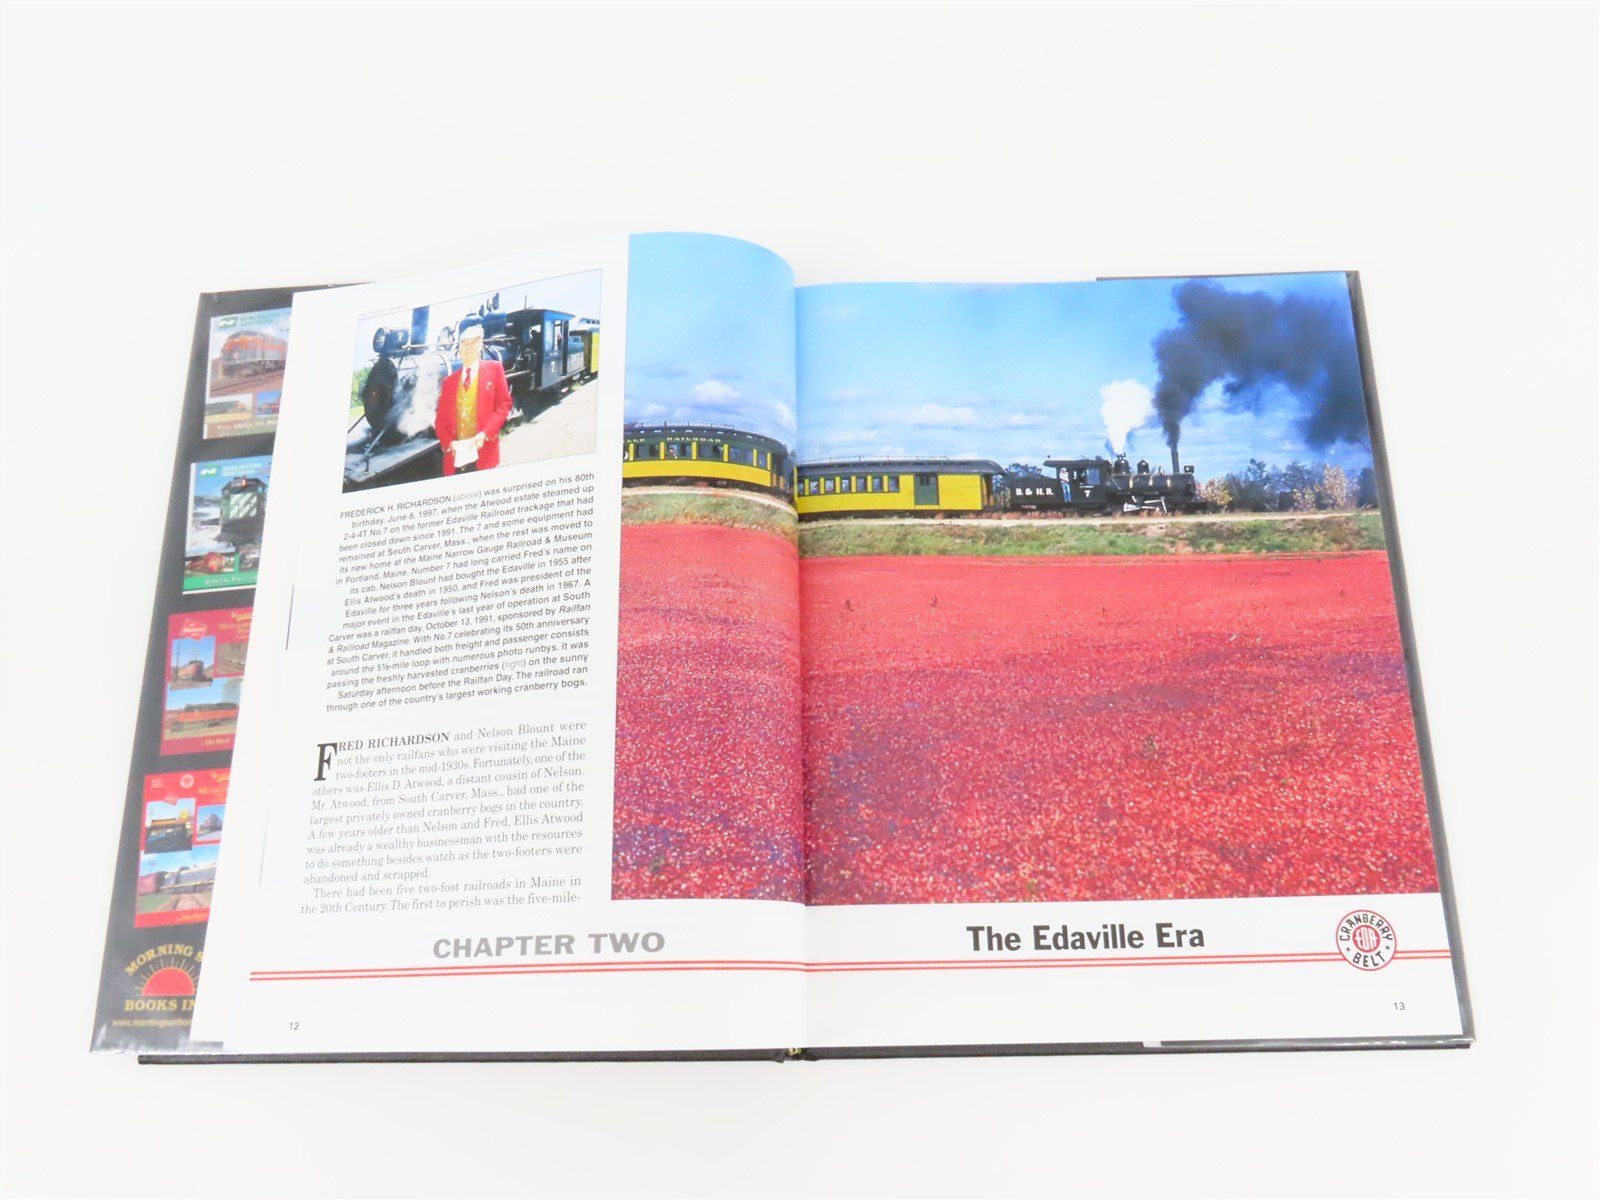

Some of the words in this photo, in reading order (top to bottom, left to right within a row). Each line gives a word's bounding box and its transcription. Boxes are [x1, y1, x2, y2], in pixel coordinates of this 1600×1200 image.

[340, 506, 385, 519] FREDERICK
[396, 495, 452, 511] RICHARDSON
[484, 488, 500, 496] was
[502, 480, 543, 493] surprised
[545, 479, 556, 487] on
[559, 476, 572, 484] his
[574, 472, 594, 482] 80th
[1025, 488, 1033, 496] &
[1084, 490, 1090, 498] 7
[352, 518, 385, 529] birthday,
[387, 514, 407, 523] June
[409, 512, 416, 520] 8,
[418, 508, 439, 518] 1997,
[441, 505, 463, 514] when
[465, 503, 478, 511] the
[480, 496, 512, 508] Atwood
[514, 492, 540, 503] estate
[542, 485, 580, 498] steamed
[582, 485, 594, 494] up
[345, 607, 377, 618] Edaville
[392, 603, 414, 612] three
[416, 600, 438, 610] years
[440, 594, 478, 605] following
[480, 588, 517, 600] Nelson's
[519, 584, 544, 595] death
[546, 583, 555, 591] in
[558, 579, 581, 590] 1967.
[584, 579, 591, 587] A
[328, 633, 354, 643] Carver
[380, 626, 406, 636] railfan
[408, 625, 424, 633] day,
[426, 620, 458, 631] October
[461, 617, 472, 626] 13,
[474, 614, 496, 624] 1991,
[497, 608, 543, 622] sponsored
[545, 607, 556, 617] by
[559, 603, 590, 614] Railfan
[328, 646, 334, 654] &
[336, 641, 370, 653] Railroad
[371, 638, 411, 650] Magazine.
[413, 635, 432, 643] With
[433, 631, 452, 642] No.7
[454, 626, 501, 639] celebrating
[516, 621, 534, 631] 50th
[536, 617, 590, 629] anniversary
[330, 666, 360, 677] around
[362, 665, 375, 673] the
[412, 659, 430, 668] loop
[432, 656, 450, 665] with
[452, 651, 495, 663] numerous
[497, 648, 523, 659] photo
[525, 644, 559, 654] runbys.
[562, 642, 568, 650] It
[570, 641, 589, 649] was
[326, 701, 358, 712] through
[378, 698, 387, 707] of
[389, 698, 402, 706] the
[404, 692, 444, 704] country's
[446, 689, 475, 701] largest
[477, 686, 512, 696] working
[514, 682, 559, 692] cranberry
[561, 679, 587, 689] bogs.
[338, 689, 374, 699] Saturday
[376, 684, 417, 695] afternoon
[418, 681, 446, 691] before
[448, 679, 462, 688] the
[464, 675, 494, 685] Railfan
[496, 673, 514, 683] Day.
[516, 671, 532, 679] The
[534, 666, 570, 678] railroad
[368, 732, 449, 749] RICHARDSON
[454, 730, 473, 741] and
[477, 727, 513, 739] Nelson
[518, 724, 554, 735] Blount
[559, 722, 586, 731] were
[336, 757, 352, 766] not
[355, 754, 372, 765] the
[373, 751, 394, 764] only
[397, 749, 436, 761] railfans
[438, 746, 459, 757] who
[461, 746, 486, 755] were
[488, 740, 528, 752] visiting
[530, 738, 548, 749] the
[551, 735, 586, 747] Maine
[310, 815, 343, 827] largest
[346, 810, 391, 826] privately
[392, 807, 425, 820] owned
[427, 804, 478, 817] cranberry
[480, 802, 503, 815] bogs
[506, 800, 516, 811] in
[519, 799, 536, 811] the
[307, 846, 326, 855] was
[327, 841, 365, 854] already
[366, 843, 373, 851] a
[376, 838, 414, 851] wealthy
[417, 835, 482, 848] businessman
[485, 831, 508, 843] with
[511, 831, 528, 842] the
[531, 830, 583, 840] resources
[305, 861, 315, 870] to
[316, 858, 330, 869] do
[330, 855, 384, 868] something
[386, 853, 422, 865] besides
[425, 850, 456, 862] watch
[458, 852, 470, 861] as
[472, 849, 490, 860] the
[492, 846, 552, 858] two-footers
[555, 846, 582, 854] were
[313, 887, 343, 899] There
[346, 886, 365, 897] had
[368, 885, 392, 896] been
[396, 883, 415, 895] five
[418, 881, 459, 894] two-foot
[464, 878, 511, 891] railroads
[515, 878, 526, 889] in
[530, 876, 566, 888] Maine
[570, 875, 581, 886] in
[966, 926, 1021, 951] The
[1033, 924, 1144, 950] Edaville
[1156, 922, 1205, 948] Era
[1340, 914, 1393, 941] CRANBERRY
[433, 934, 575, 958] CHAPTER
[588, 932, 665, 953] TWO
[124, 944, 194, 976] MORNING
[1353, 951, 1385, 967] BELT
[124, 999, 178, 1012] BOOKS
[1394, 1002, 1405, 1010] 13
[290, 1022, 299, 1030] 12
